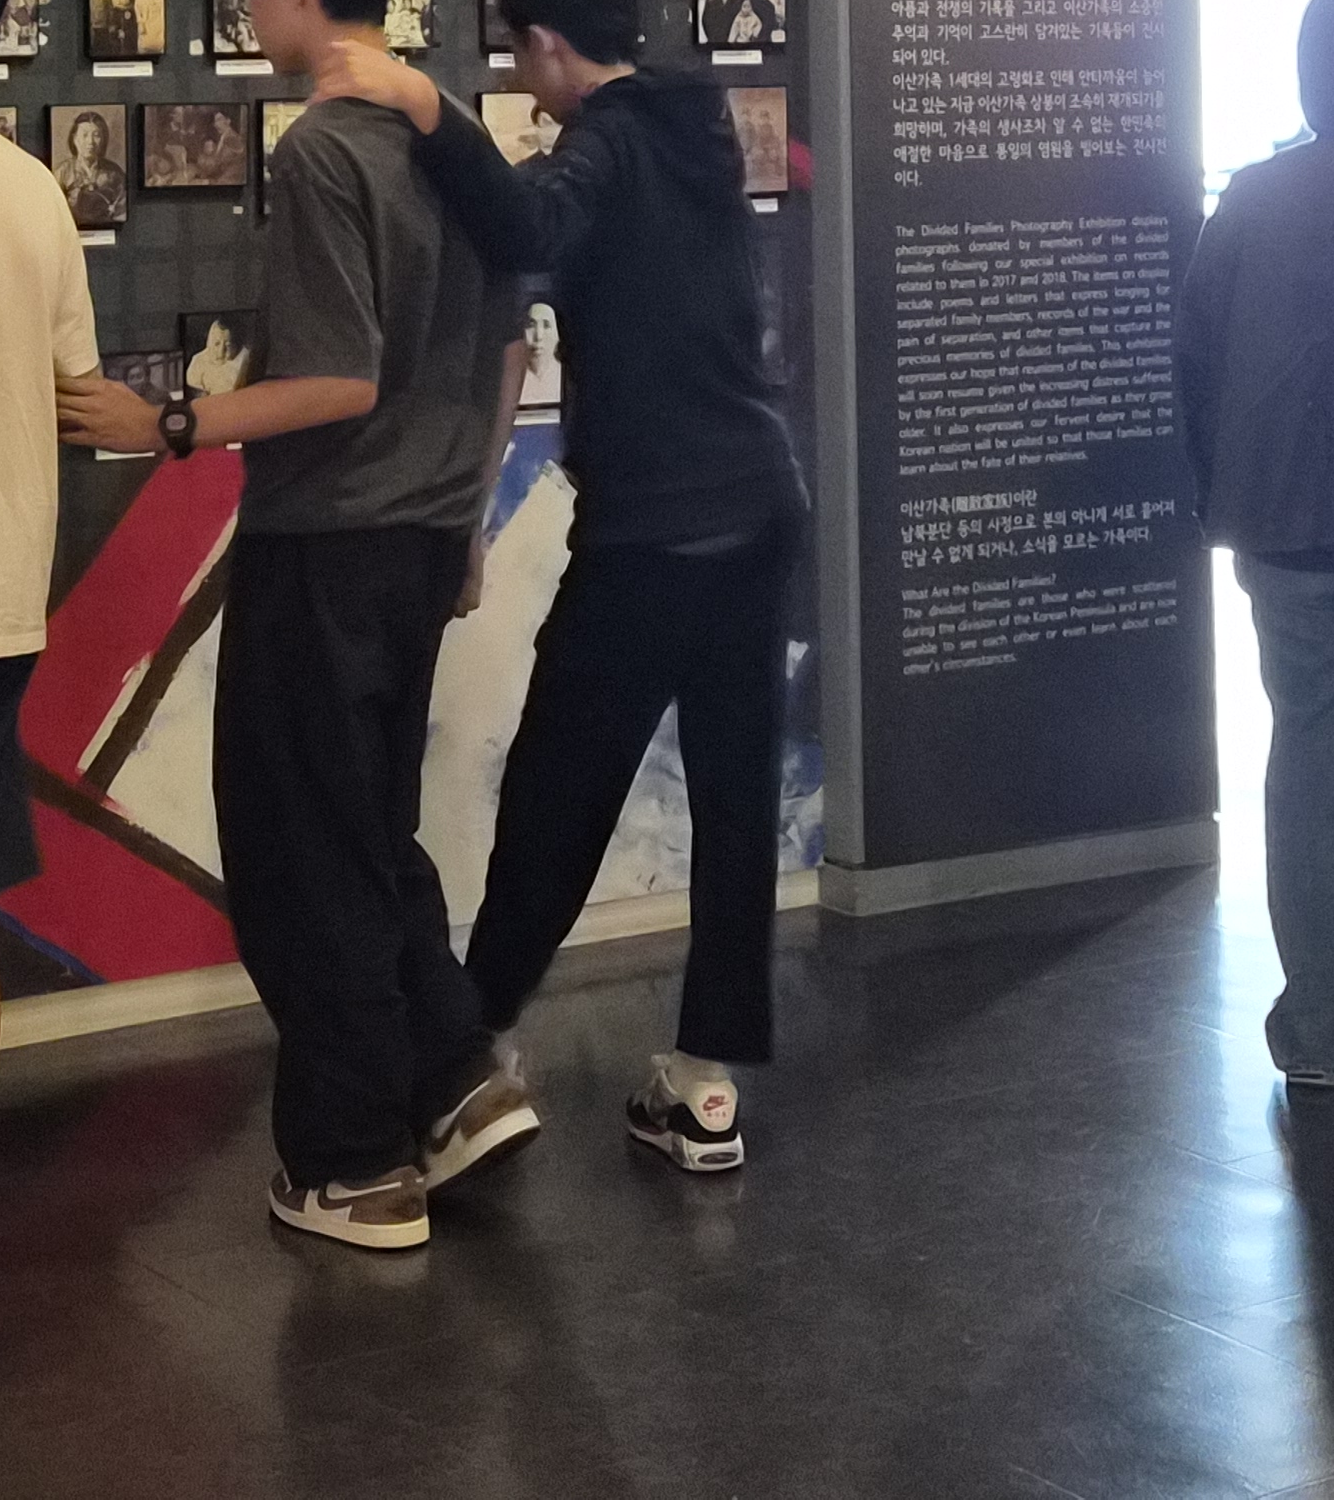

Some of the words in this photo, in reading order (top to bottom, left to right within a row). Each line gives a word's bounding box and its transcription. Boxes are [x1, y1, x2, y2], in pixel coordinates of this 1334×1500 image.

[890, 0, 930, 19] 아픔과
[936, 0, 973, 19] 전쟁의
[891, 23, 929, 43] 추억과
[936, 23, 973, 43] 기억이
[979, 23, 1028, 42] 고스란히
[1088, 21, 1135, 40] 기록들이
[891, 47, 917, 66] 되어
[920, 47, 950, 66] 있다.
[892, 71, 943, 91] 이산가족
[948, 69, 993, 89] 1세대의
[996, 69, 1046, 89] 고령화로
[1050, 69, 1075, 87] 인해
[892, 96, 919, 115] 나고
[921, 95, 948, 114] 있는
[950, 94, 975, 114] 지금
[977, 93, 1028, 113] 이산가족
[1030, 93, 1067, 112] 상봉이
[1068, 91, 1105, 110] 조속히
[893, 120, 948, 139] 희망하며,
[953, 118, 991, 137] 가족의
[997, 117, 1047, 137] 생사조차
[1053, 116, 1066, 135] 알
[1071, 116, 1084, 134] 수
[1089, 115, 1114, 134] 없는
[893, 144, 932, 164] 애절한
[938, 143, 990, 162] 마음으로
[995, 141, 1032, 160] 통일의
[894, 169, 923, 187] 이다.
[895, 224, 915, 237] The
[921, 223, 959, 237] Divided
[1010, 219, 1074, 233] Photography
[1079, 217, 1127, 229] Exhibition
[968, 239, 1010, 253] donated
[1019, 239, 1031, 252] by
[1114, 253, 1128, 262] on
[896, 279, 932, 293] related
[935, 280, 947, 290] to
[992, 274, 1017, 288] 2017
[1072, 270, 1090, 282] The
[1122, 270, 1135, 280] on
[923, 333, 936, 346] of
[999, 346, 1010, 359] of
[1067, 359, 1078, 371] of
[898, 409, 912, 422] by
[1017, 398, 1028, 411] of
[994, 437, 1008, 449] be
[1004, 453, 1016, 466] of
[900, 521, 952, 544] 남북분단
[956, 518, 982, 539] 등의
[987, 513, 1037, 534] 사정으로
[1042, 508, 1067, 530] 본의
[1070, 505, 1107, 525] 아니게
[1111, 503, 1137, 521] 서로
[901, 547, 927, 569] 만날
[931, 546, 945, 564] 수
[948, 543, 974, 564] 없게
[1021, 534, 1058, 555] 소식을
[1062, 530, 1100, 550] 모르는
[930, 586, 950, 598] Are
[902, 607, 923, 620] The
